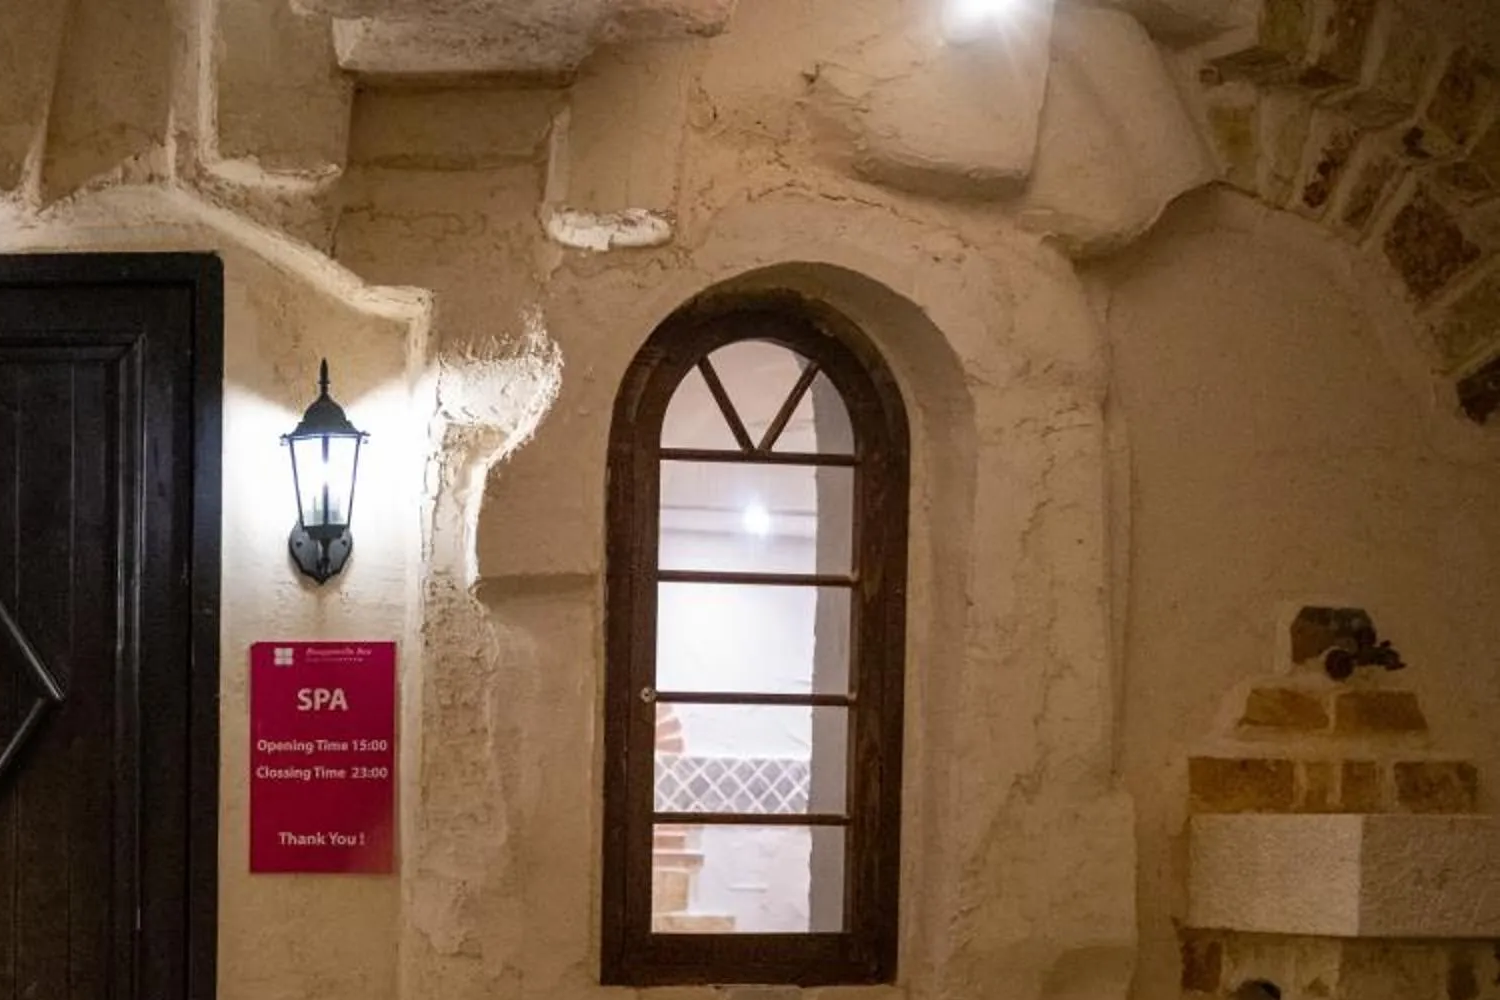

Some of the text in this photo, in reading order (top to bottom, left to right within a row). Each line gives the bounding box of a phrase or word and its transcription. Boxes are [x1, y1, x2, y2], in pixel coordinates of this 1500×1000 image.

[297, 687, 348, 711] SPA
[257, 739, 388, 754] Opening Time 15:00
[314, 766, 346, 779] Time
[351, 766, 388, 779] 23:00
[277, 832, 325, 845] Thank
[328, 832, 356, 845] You
